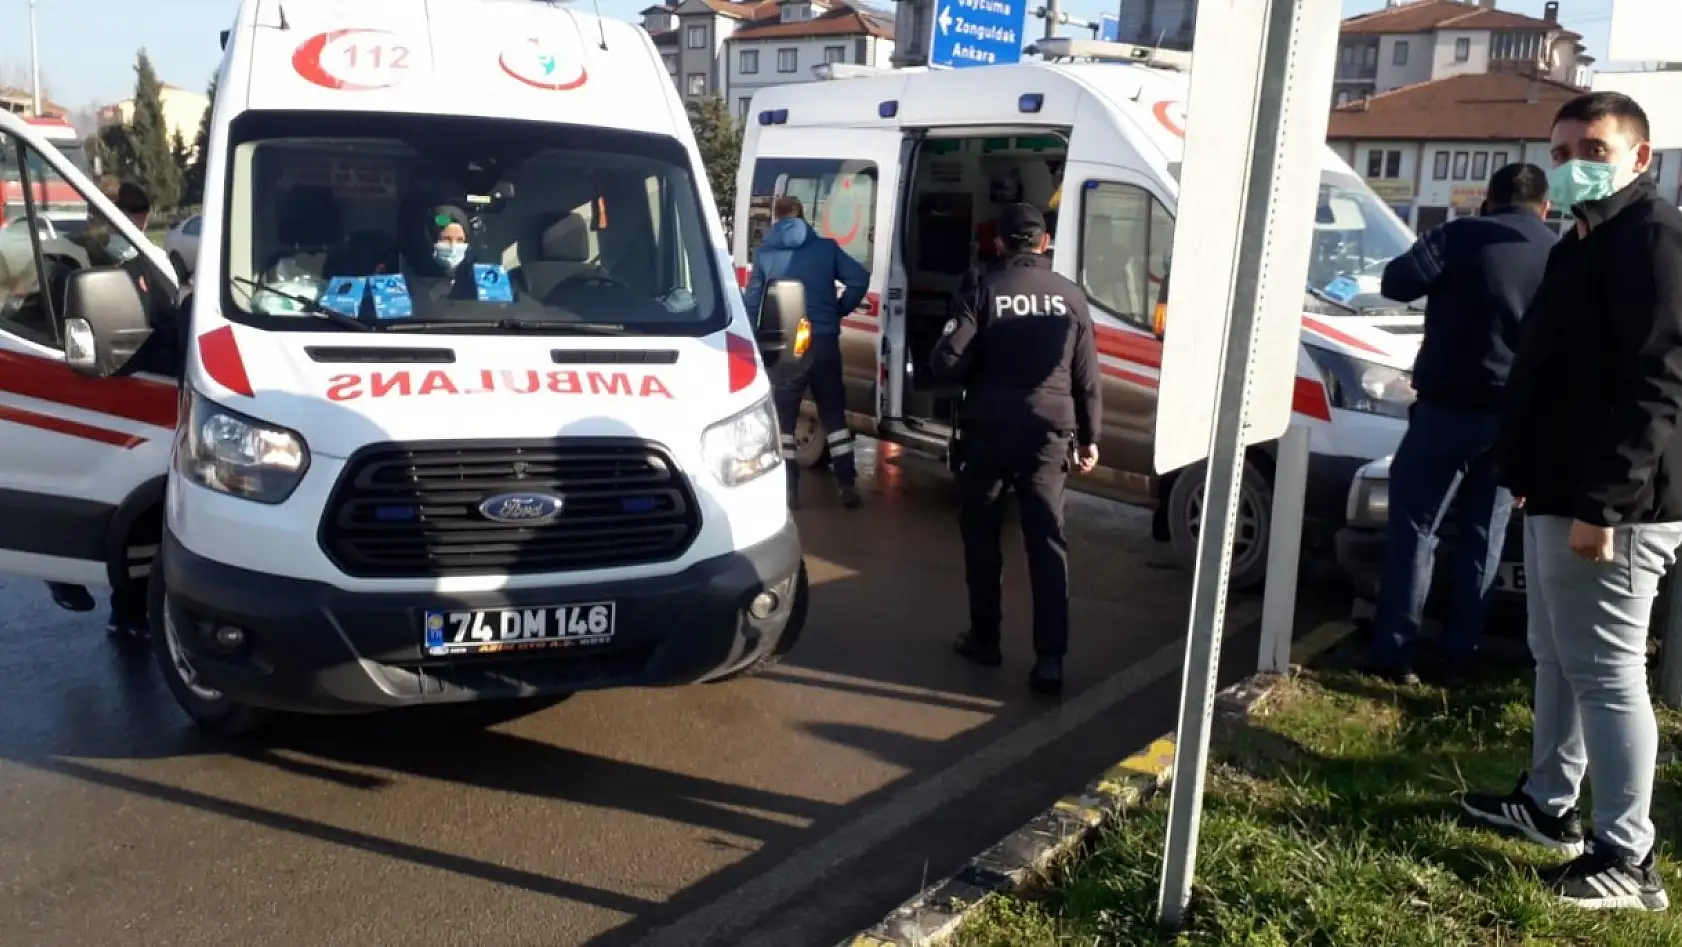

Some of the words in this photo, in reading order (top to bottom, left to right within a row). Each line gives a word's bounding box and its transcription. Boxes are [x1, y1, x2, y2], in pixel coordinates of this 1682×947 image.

[955, 17, 1016, 44] Zonguldak
[343, 45, 410, 69] 112
[952, 42, 996, 63] Ankara
[499, 499, 545, 520] Ford
[449, 611, 493, 643] 74
[500, 608, 547, 639] DM
[554, 605, 608, 636] 146
